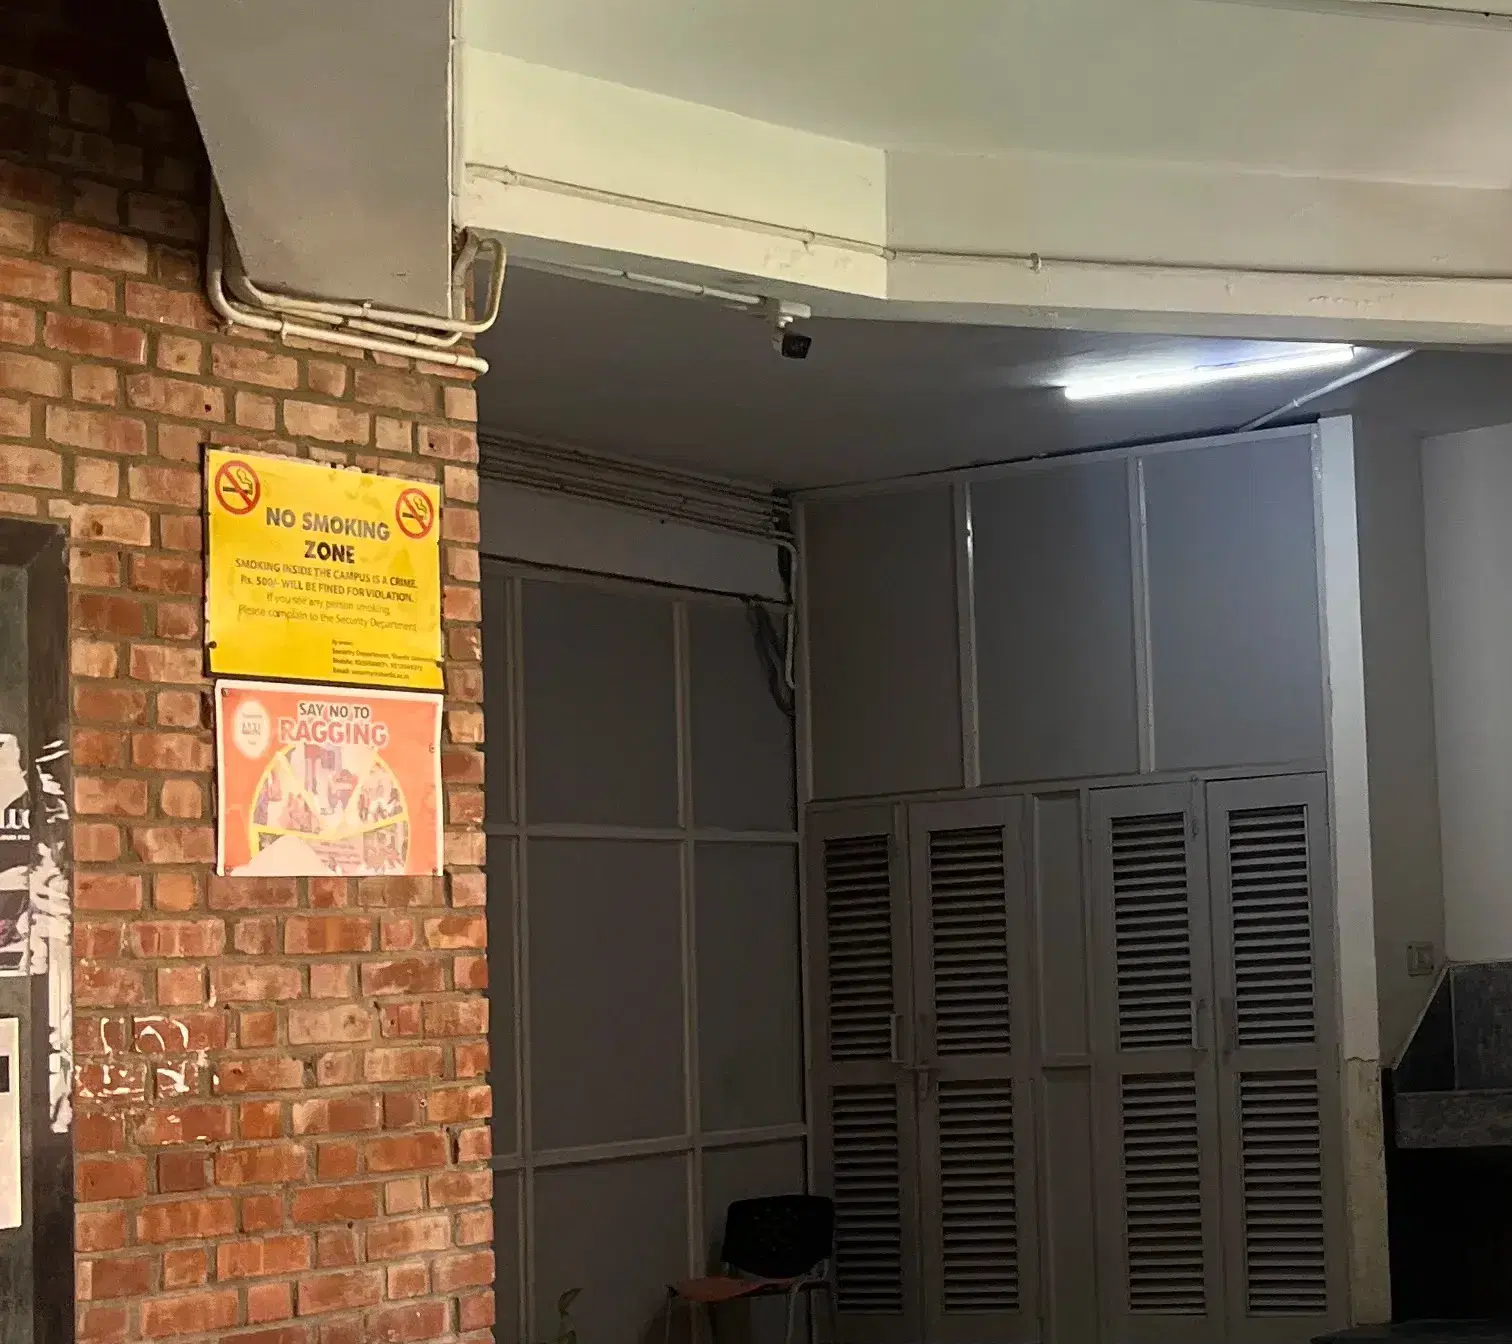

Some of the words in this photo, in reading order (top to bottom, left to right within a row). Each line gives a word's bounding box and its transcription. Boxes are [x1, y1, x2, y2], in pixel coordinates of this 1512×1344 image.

[266, 507, 296, 528] NO
[302, 512, 390, 541] SMOKING
[304, 540, 355, 564] ZONE
[235, 558, 280, 572] SMOKING
[282, 564, 312, 576] INSIDE
[314, 567, 331, 578] THE
[333, 570, 371, 583] CAMPUS
[372, 574, 380, 584] IS
[382, 575, 388, 585] A
[280, 578, 304, 591] WILL
[305, 581, 317, 592] BE
[319, 583, 345, 595] FINED
[346, 586, 367, 597] FOR
[275, 595, 291, 605] you
[308, 597, 324, 608] any
[325, 601, 354, 612] person
[268, 607, 308, 622] complain
[310, 612, 320, 622] to
[320, 613, 334, 623] the
[335, 614, 369, 629] Security
[300, 703, 324, 716] SAY
[330, 705, 348, 718] NO
[353, 706, 370, 719] TO
[280, 719, 388, 746] RAGGING
